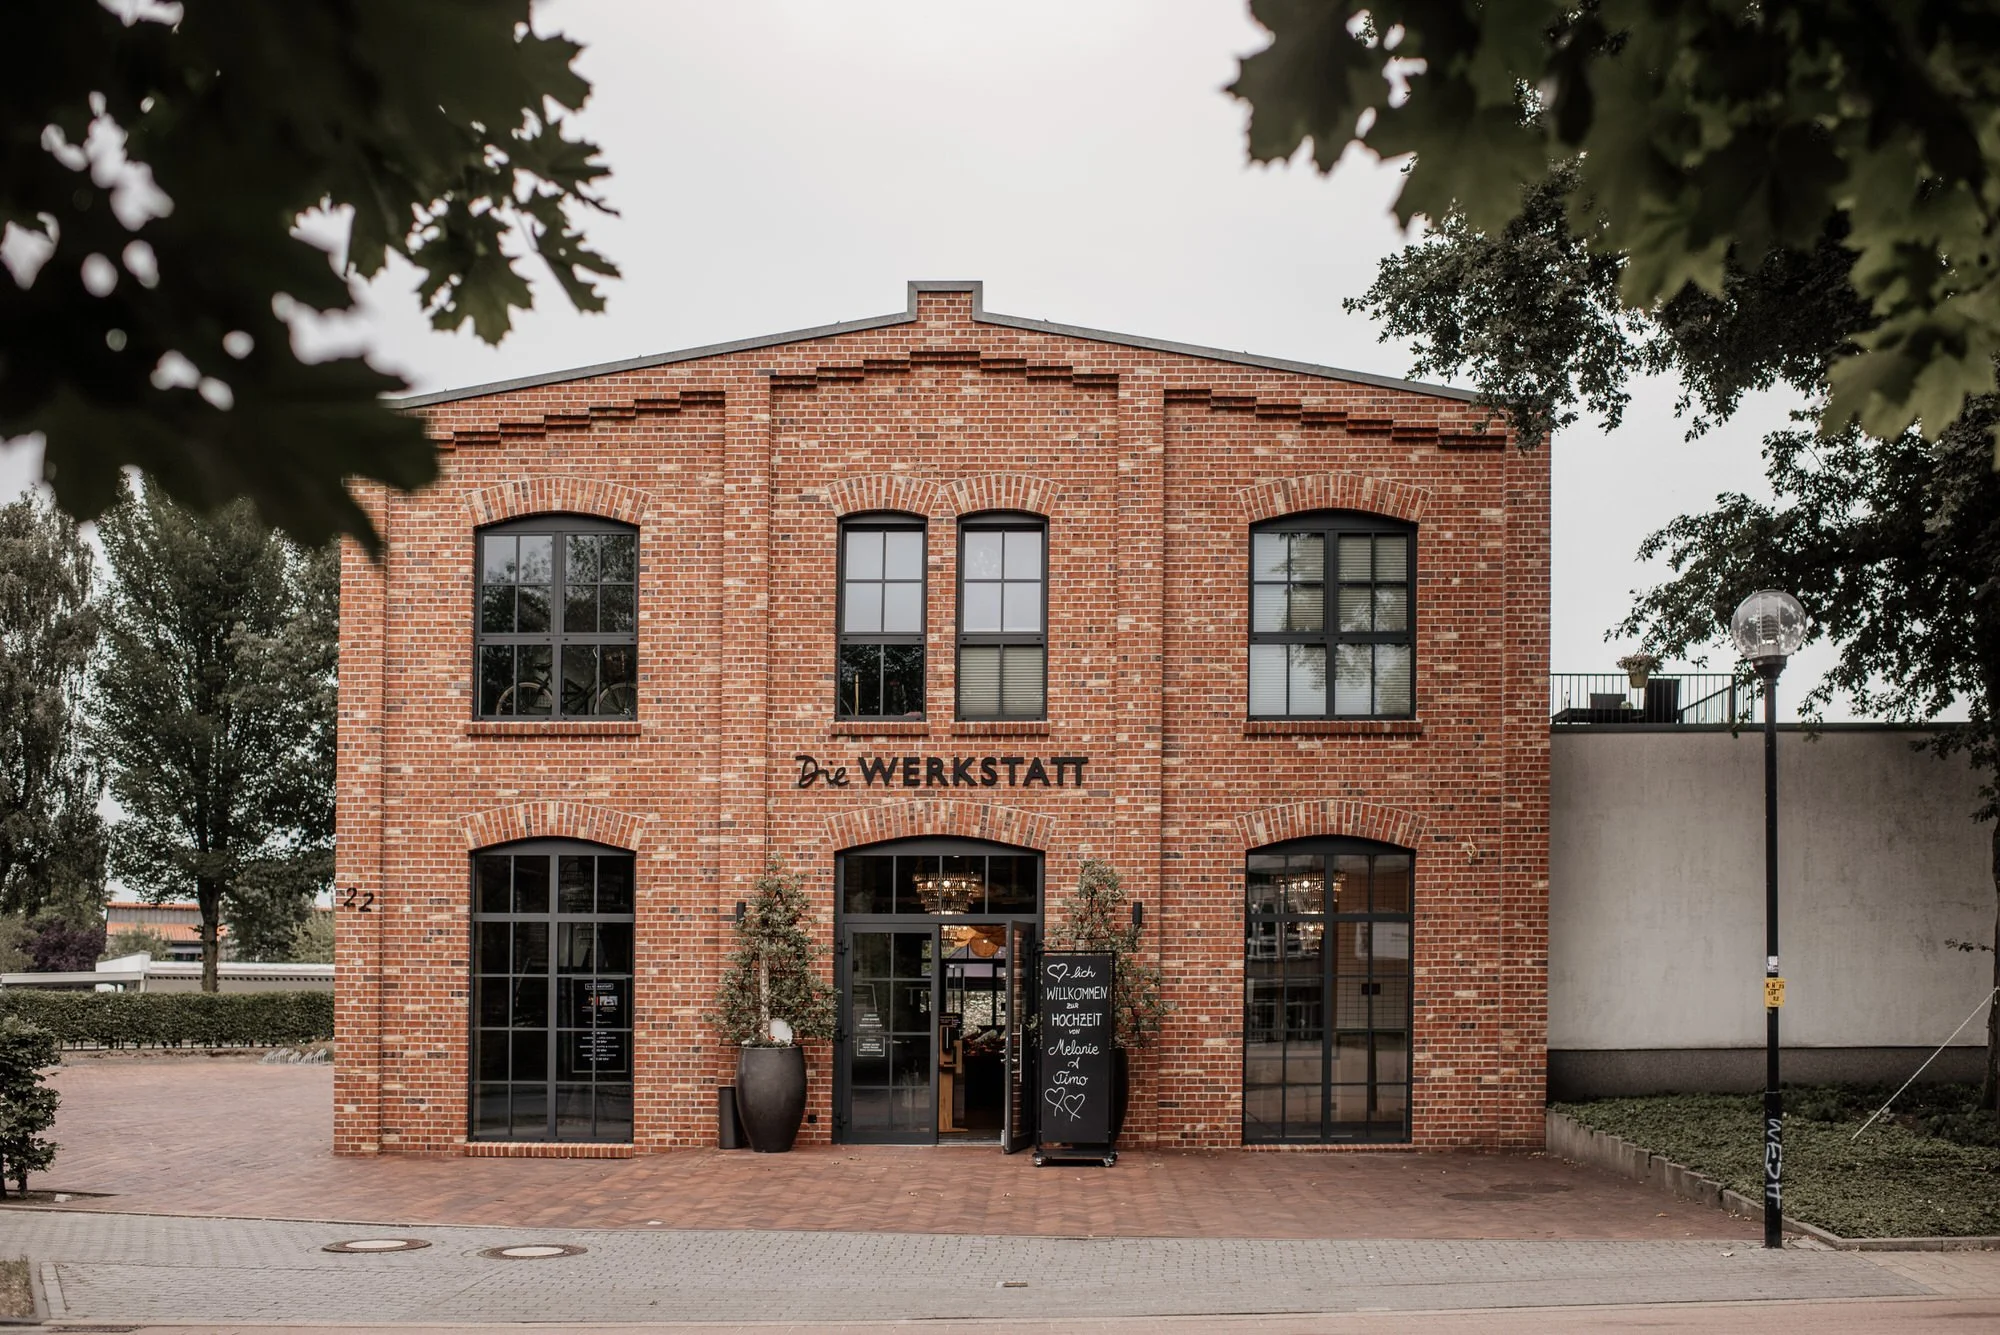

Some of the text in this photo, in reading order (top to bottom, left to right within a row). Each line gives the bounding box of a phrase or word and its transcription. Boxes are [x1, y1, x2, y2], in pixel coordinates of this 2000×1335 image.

[795, 754, 1089, 788] Die WERKSTATT
[343, 887, 375, 912] 22
[1051, 1013, 1103, 1027] HOCHZEIT
[1047, 1038, 1100, 1056] Melanie
[1052, 1070, 1089, 1086] Timo
